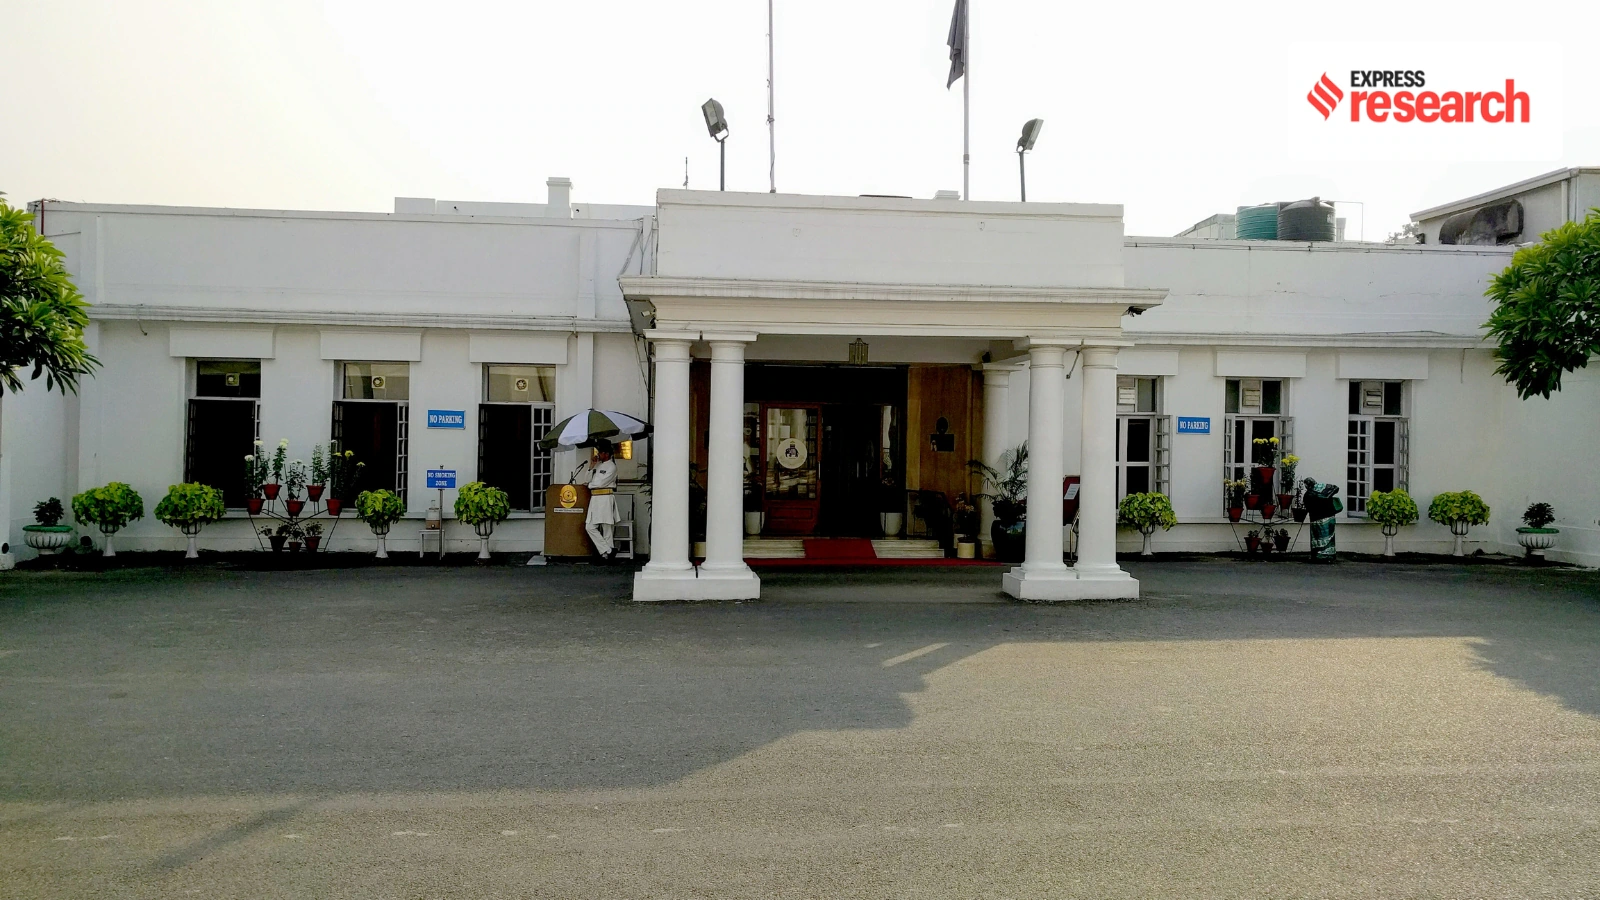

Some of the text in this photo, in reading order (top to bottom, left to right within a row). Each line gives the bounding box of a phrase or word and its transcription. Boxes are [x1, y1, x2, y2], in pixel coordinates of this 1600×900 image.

[429, 414, 462, 424] NO PARKING
[1179, 421, 1208, 430] NO PARKING
